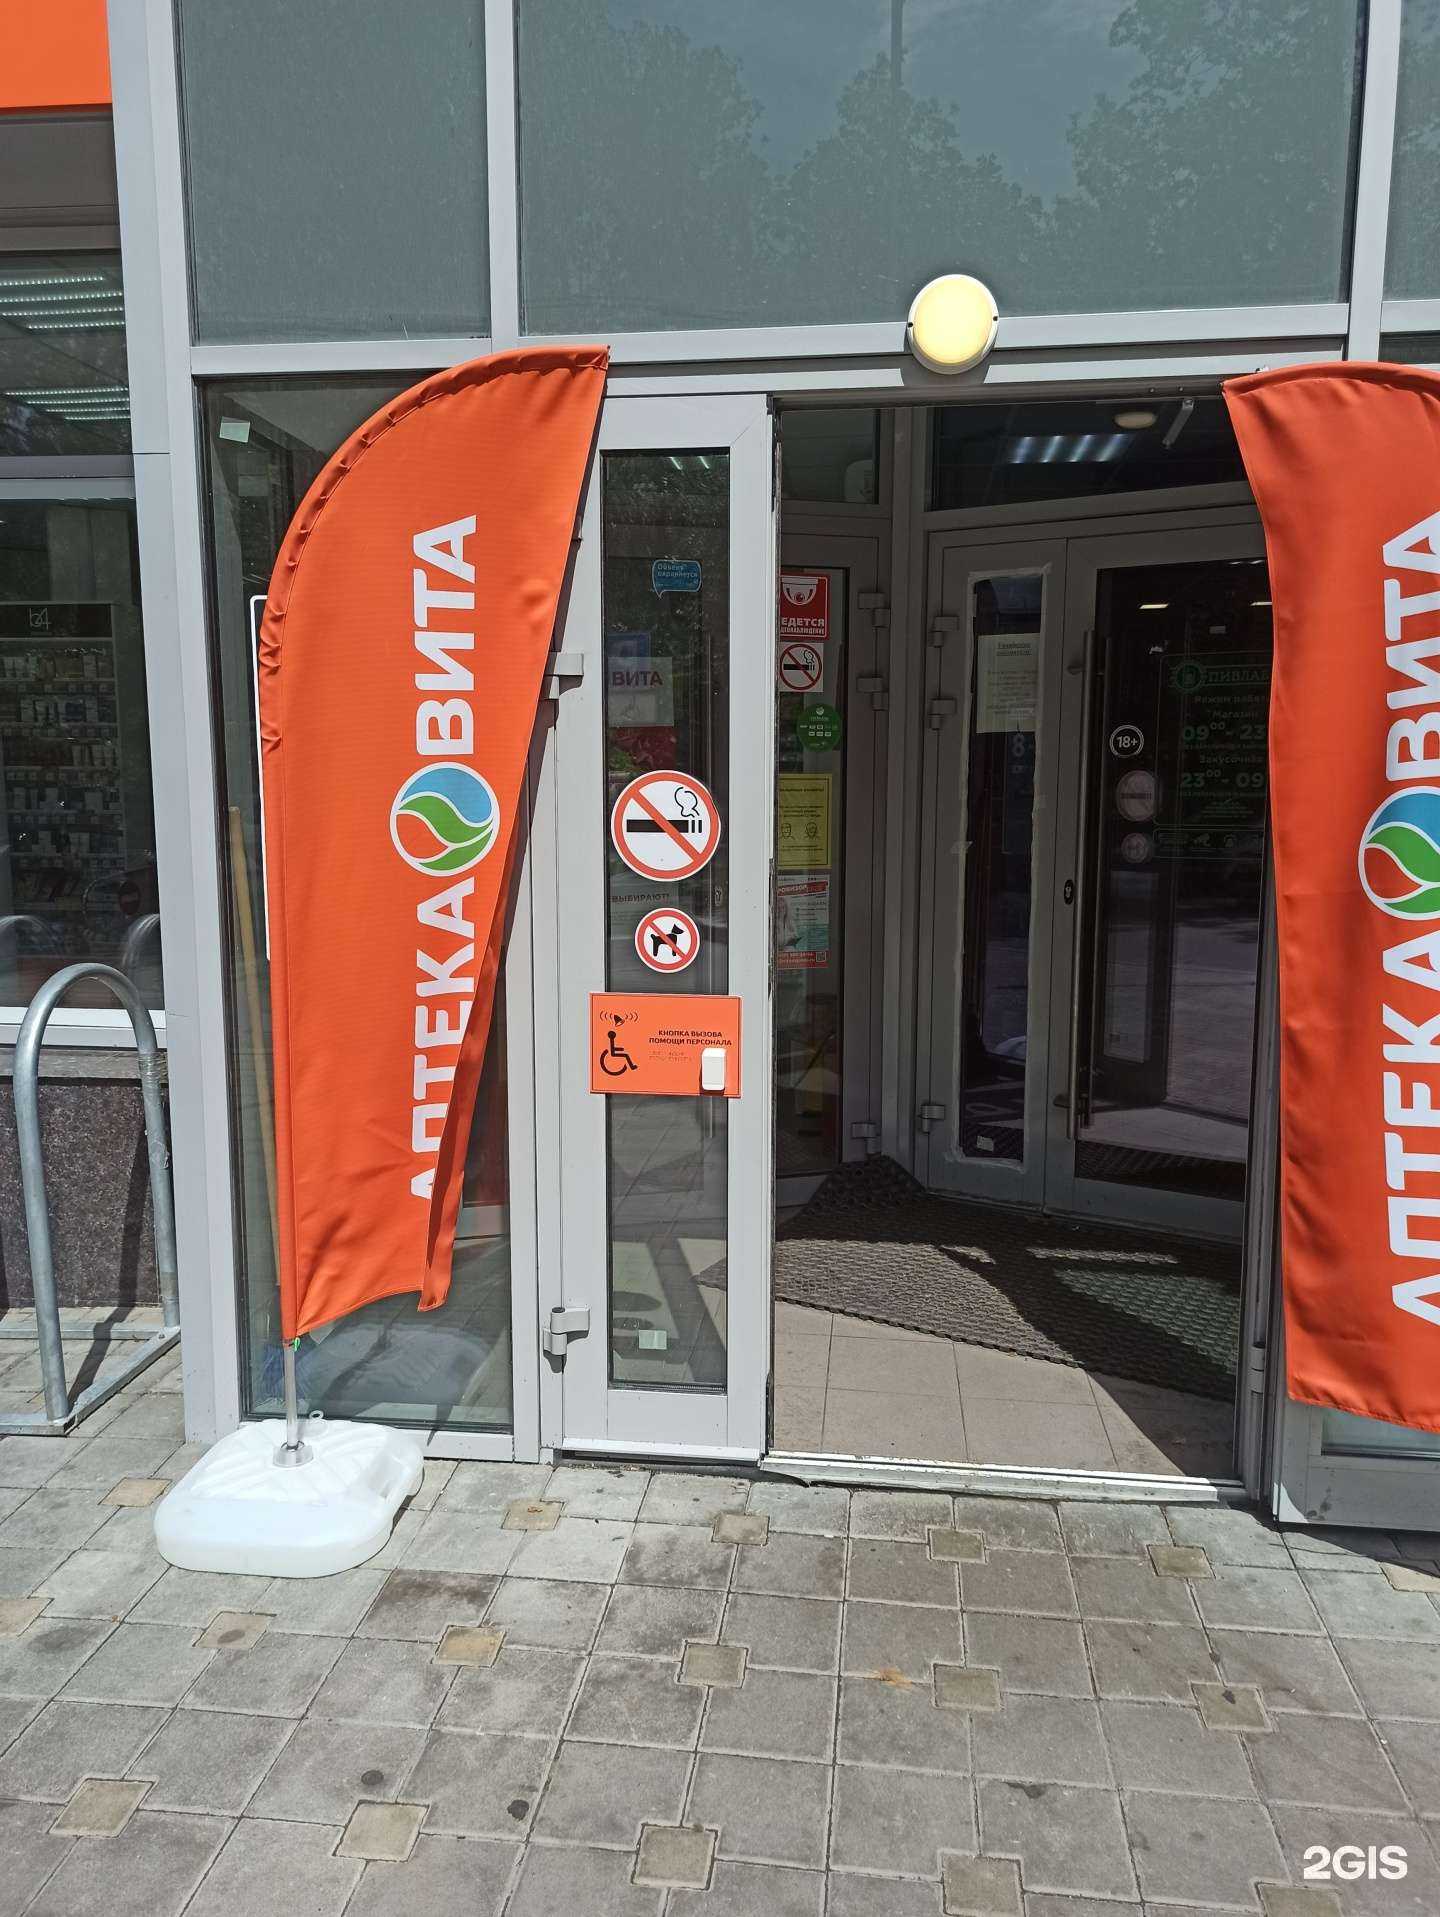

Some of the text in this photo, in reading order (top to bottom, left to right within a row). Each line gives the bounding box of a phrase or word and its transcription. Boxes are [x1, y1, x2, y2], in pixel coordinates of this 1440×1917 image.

[781, 617, 825, 628] ЕДЕТСЯ
[413, 514, 476, 755] ВИТА
[781, 627, 825, 635] ДЕОНАБЛЮДЕНИЕ
[1382, 511, 1440, 782] ВИТА
[611, 671, 663, 687] ВИТА
[1116, 736, 1138, 748] 18+
[658, 1030, 723, 1038] КНОПКА ВЫЗОВА
[649, 1037, 732, 1047] ПОМОЩИ ПЕРСОНАЛА
